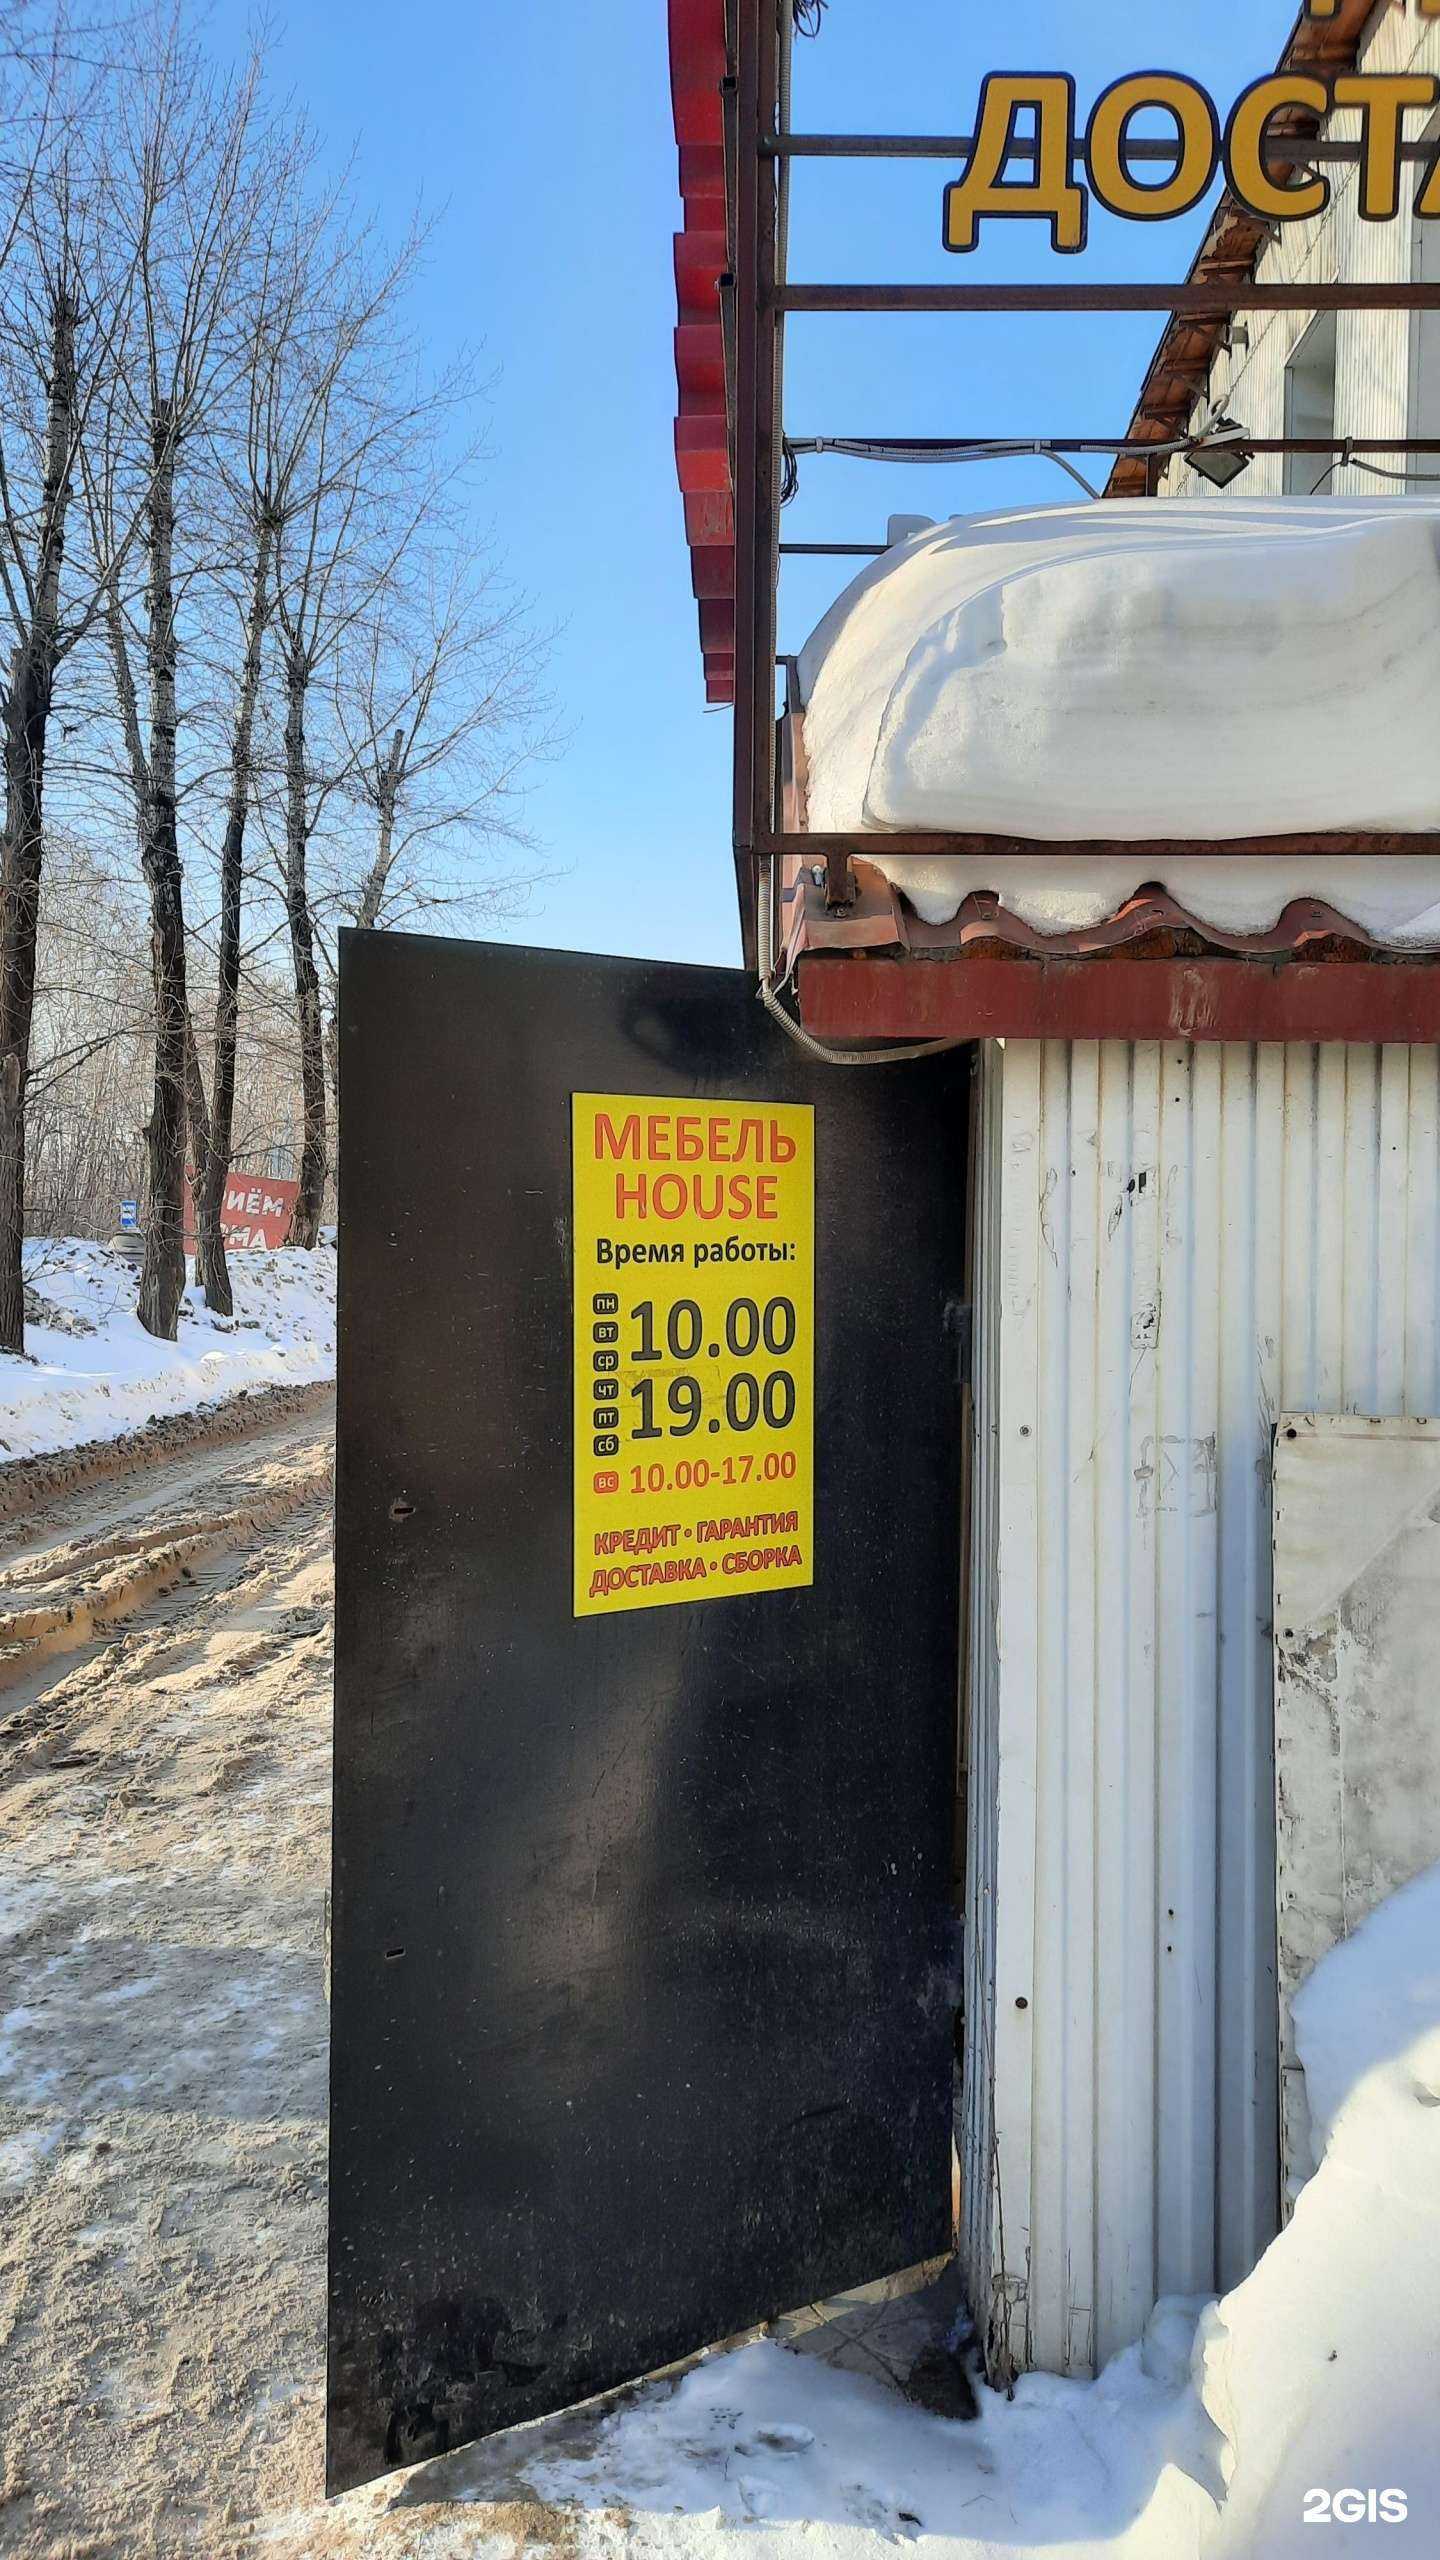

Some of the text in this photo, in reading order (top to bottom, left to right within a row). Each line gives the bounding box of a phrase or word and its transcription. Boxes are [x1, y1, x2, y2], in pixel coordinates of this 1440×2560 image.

[942, 69, 1440, 254] ДОСТ
[594, 1113, 797, 1163] МЕБЕЛЬ
[223, 1187, 284, 1218] ИЁМ
[614, 1172, 779, 1220] HOUSE
[596, 1235, 796, 1270] Время работы:
[630, 1296, 796, 1361] 10.00
[630, 1370, 796, 1439] 19.00
[630, 1451, 797, 1494] 10.00-17.00
[594, 1511, 798, 1555] КРЕДИТ ГАРАНТИЯ
[589, 1545, 802, 1597] ДОСТАВКА СБОРКА
